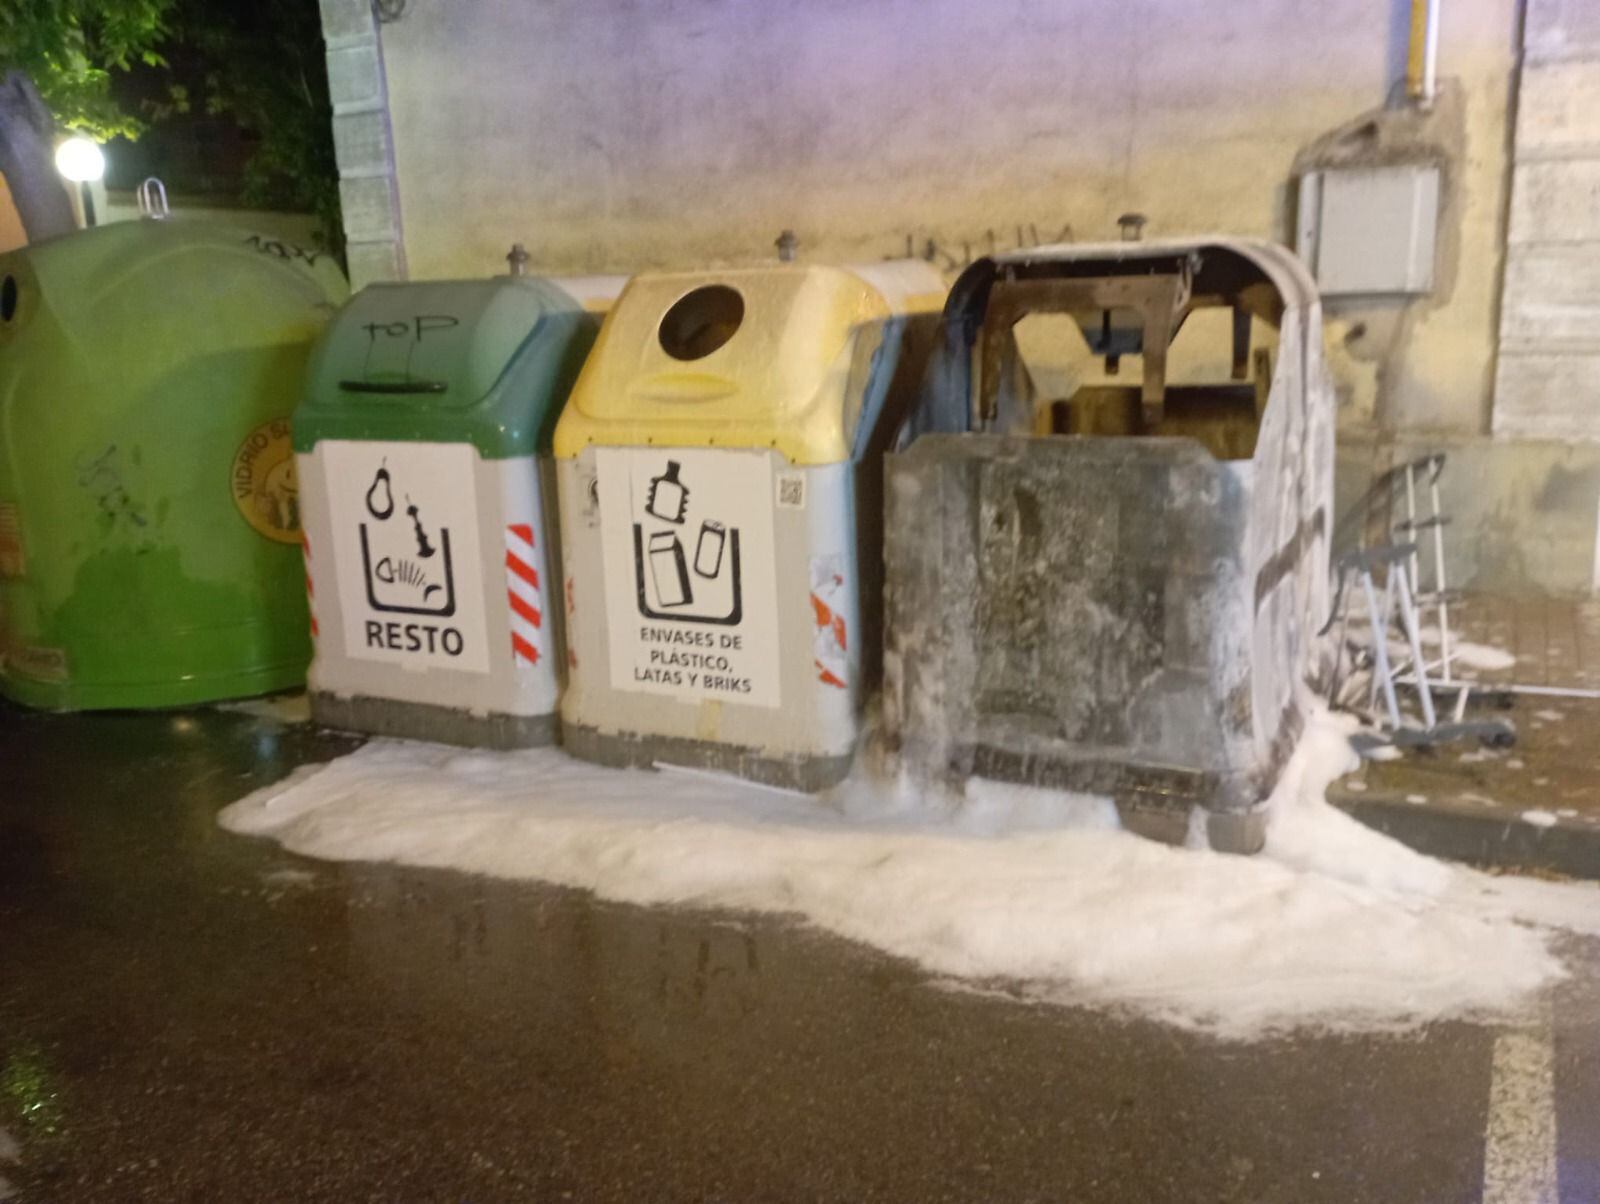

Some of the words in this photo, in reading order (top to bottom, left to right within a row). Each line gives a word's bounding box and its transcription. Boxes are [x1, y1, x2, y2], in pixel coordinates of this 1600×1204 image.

[235, 433, 268, 498] VIDRIO
[365, 619, 464, 656] RESTO
[640, 627, 714, 648] ENVASES
[720, 634, 743, 650] DE
[650, 647, 733, 673] PLÁSTICO,
[634, 667, 682, 685] LATAS
[688, 673, 698, 687] Y
[703, 675, 752, 693] BRIKS
